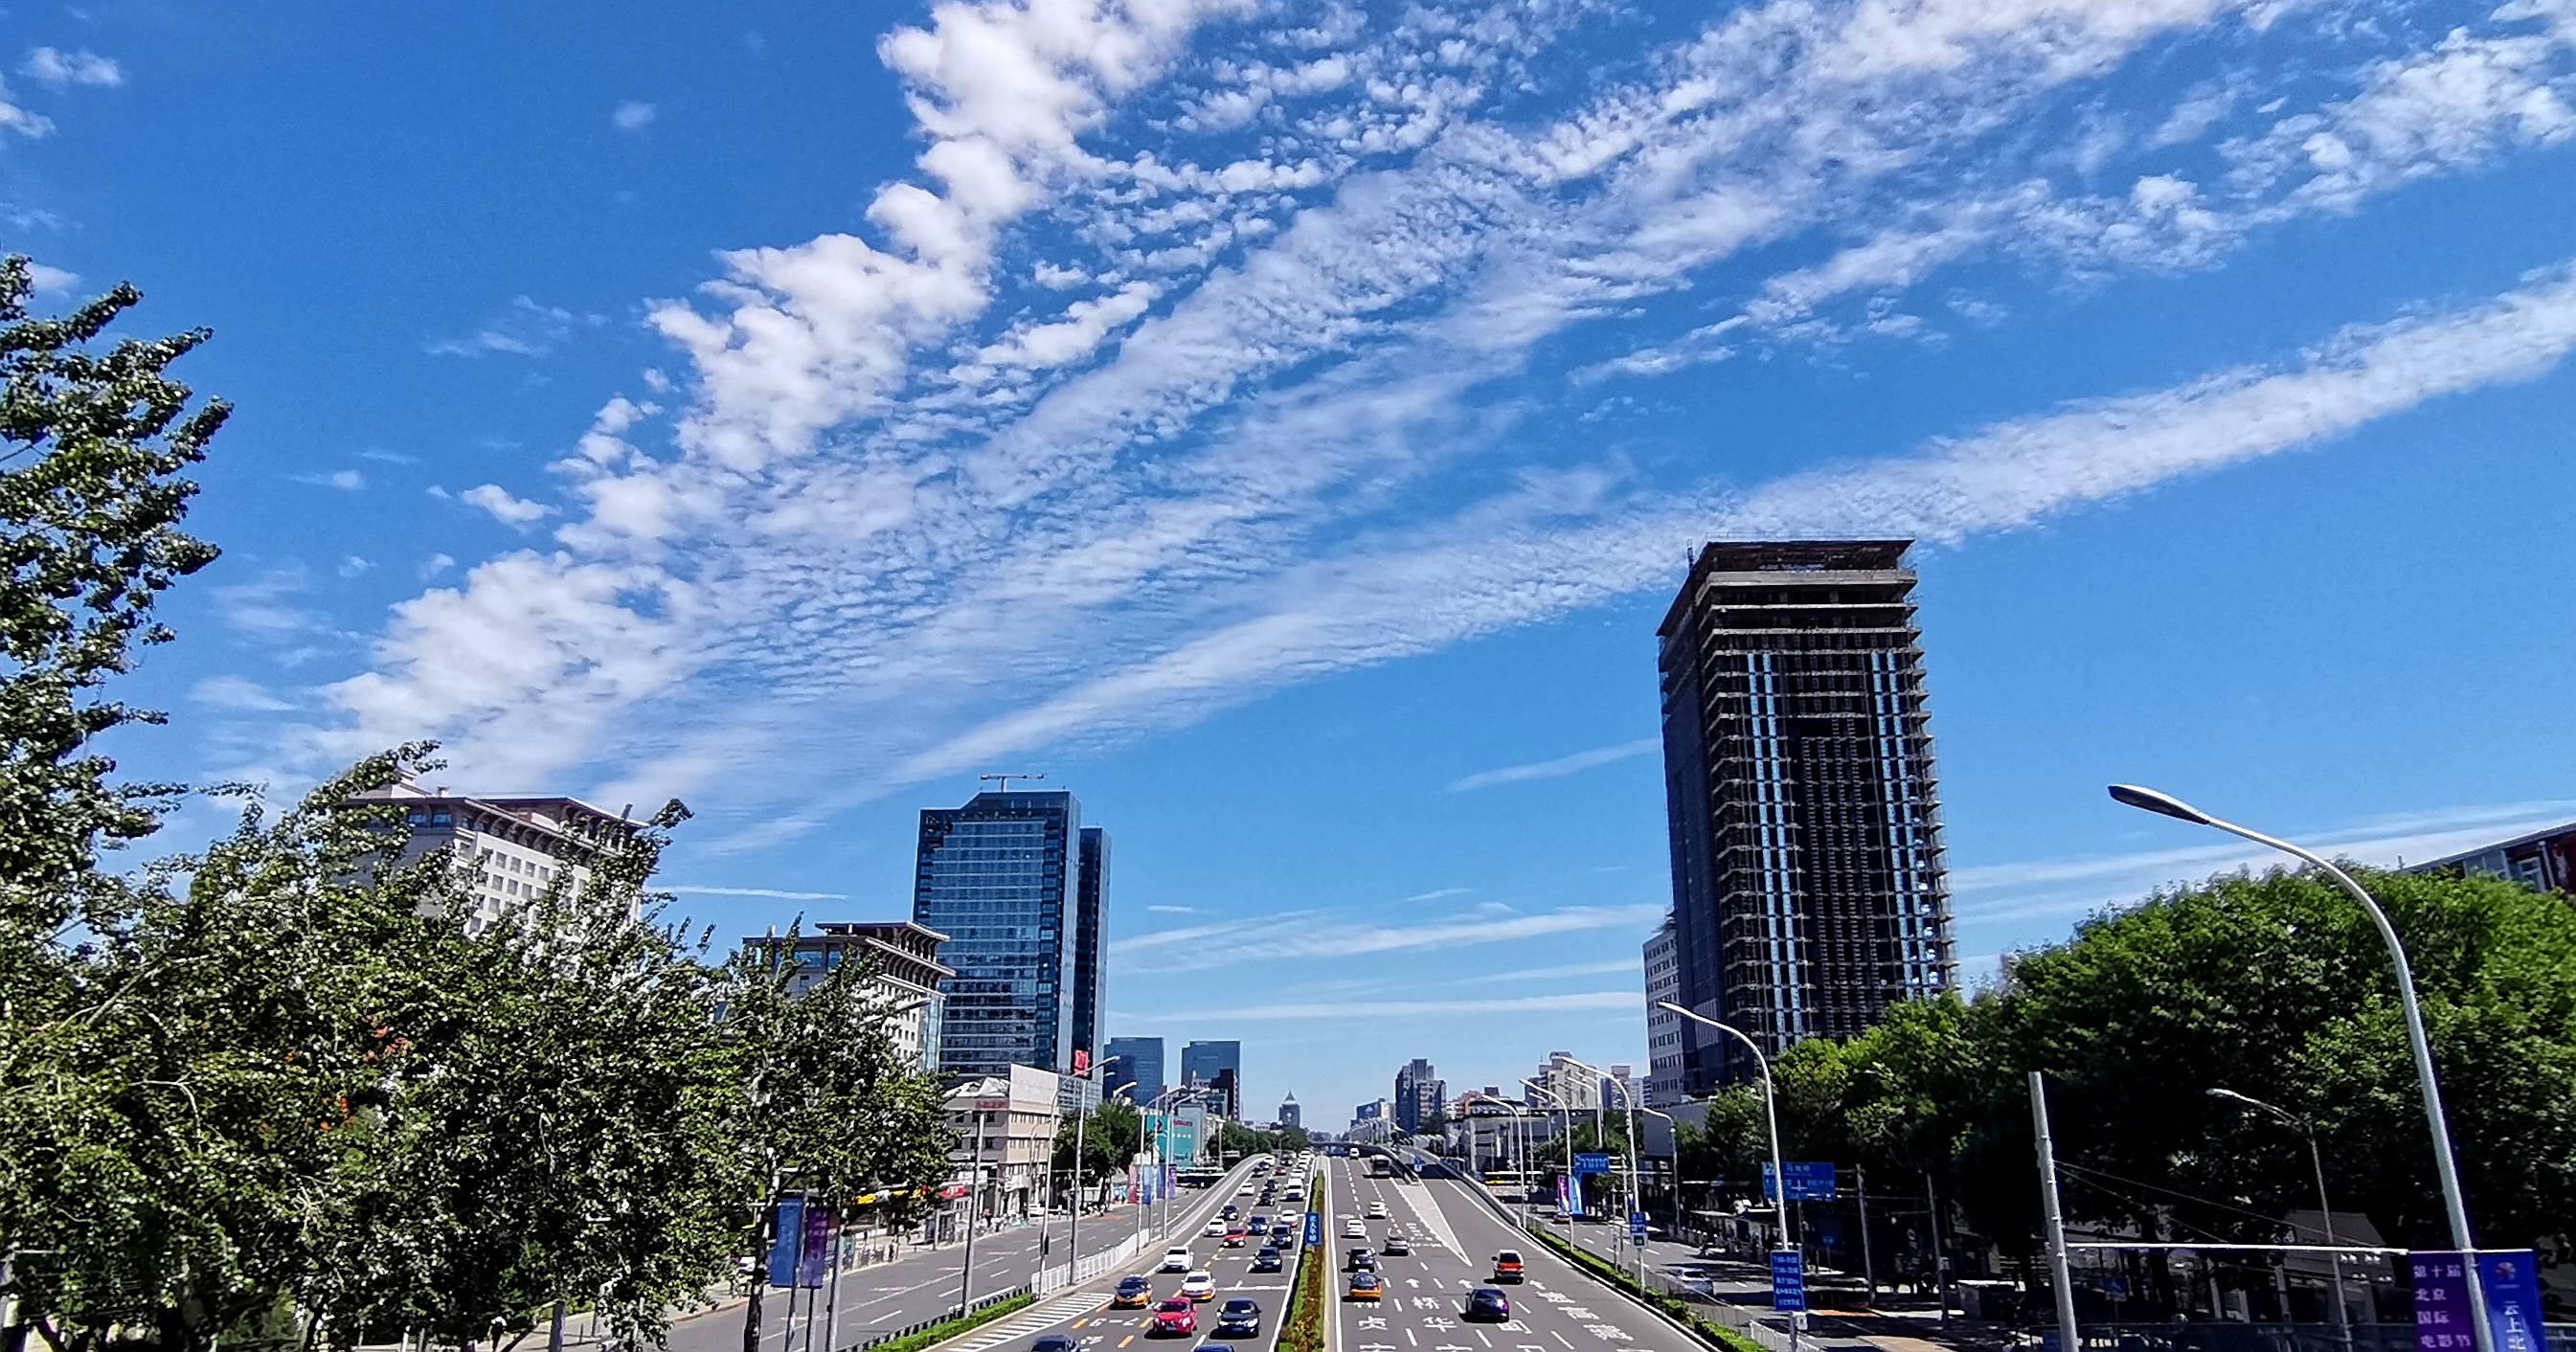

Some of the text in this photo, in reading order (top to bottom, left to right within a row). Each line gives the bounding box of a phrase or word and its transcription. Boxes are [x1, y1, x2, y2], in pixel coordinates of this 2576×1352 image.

[2413, 1265, 2461, 1278] 第十届
[2415, 1288, 2447, 1302] 北京
[2417, 1311, 2450, 1325] 国际
[2421, 1335, 2472, 1349] 电影节
